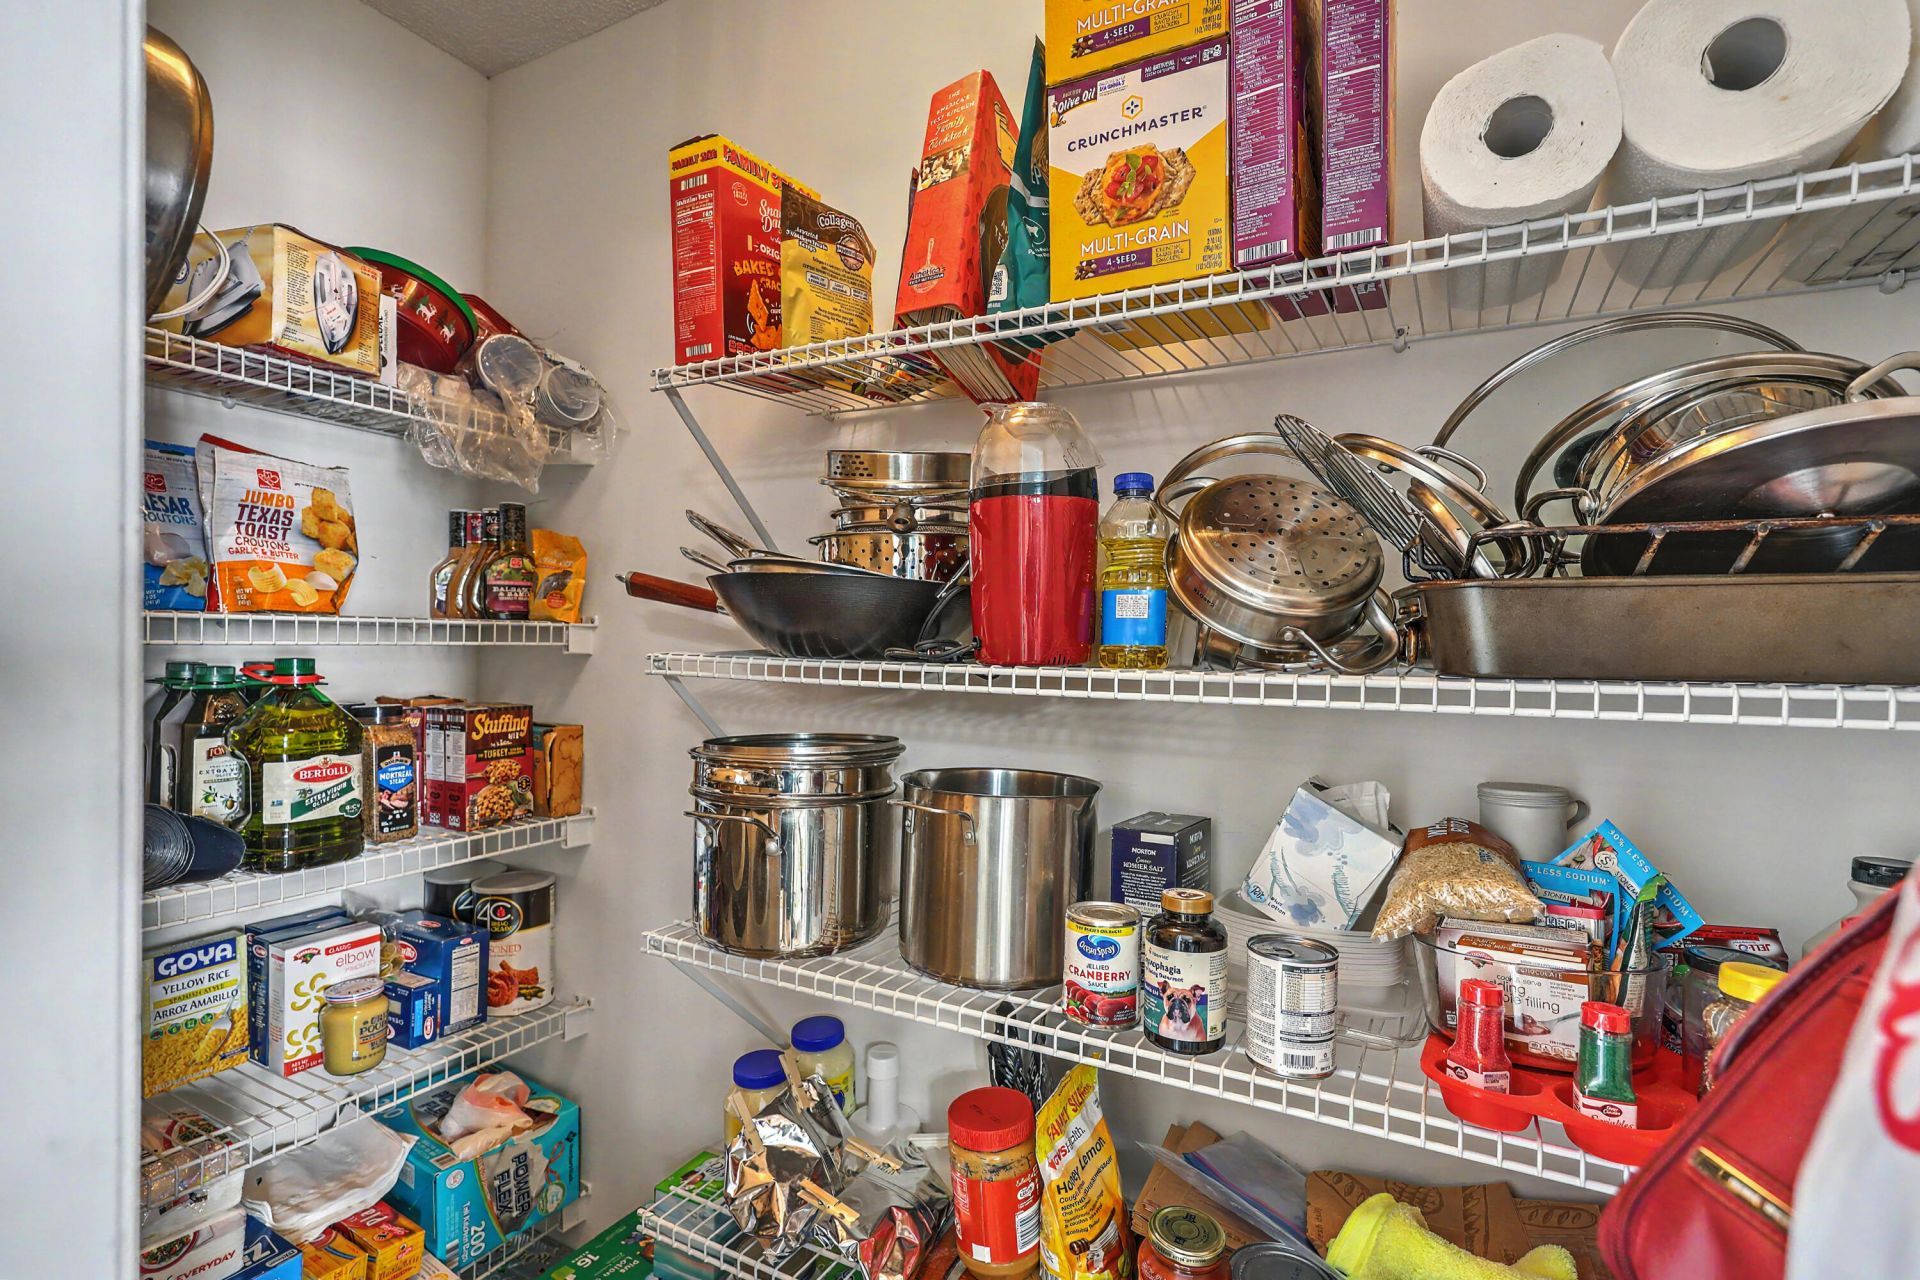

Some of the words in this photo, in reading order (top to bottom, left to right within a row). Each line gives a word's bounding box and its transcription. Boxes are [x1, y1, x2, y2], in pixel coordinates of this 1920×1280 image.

[1104, 24, 1135, 40] 4-SEED
[1057, 95, 1080, 114] Olive
[1082, 88, 1095, 101] Oil
[1068, 107, 1203, 152] CRUNCHMASTER
[723, 144, 769, 184] FAMILY
[818, 213, 855, 230] Collagen
[1081, 219, 1190, 257] MULTI-GRAIN
[760, 244, 780, 260] ORIG
[1106, 253, 1137, 266] 4-SEED
[734, 259, 774, 276] BAKED
[144, 494, 194, 516] ESAR
[240, 489, 295, 509] JUMBO
[237, 504, 294, 527] TEXAS
[235, 522, 291, 541] TOAST
[228, 547, 258, 556] GARLIC
[235, 536, 291, 551] CROUTONS
[471, 714, 530, 740] Stuffing
[299, 765, 349, 780] BERTOLLI
[379, 770, 413, 780] MONTREAL
[1131, 847, 1156, 856] MORTON
[1608, 830, 1625, 848] 30%
[1625, 849, 1650, 873] LESS
[1123, 861, 1148, 870] KOSHER
[1537, 866, 1562, 877] LESS
[328, 944, 352, 954] CLASSIC
[335, 947, 376, 968] elbow
[1096, 945, 1115, 958] Spray
[158, 943, 236, 976] GOYA
[1086, 963, 1109, 971] JELLIED
[1068, 964, 1131, 981] CRANBERRY
[1496, 973, 1514, 981] cook
[1519, 968, 1563, 980] CHOCOLATE
[163, 977, 205, 995] YELLOW
[208, 970, 231, 983] RICE
[154, 1006, 188, 1021] ARROZ
[190, 988, 239, 1010] AMARILLO
[1525, 996, 1560, 1014] filling
[1056, 1166, 1081, 1195] Honey
[1079, 1136, 1106, 1171] Lemon
[494, 1168, 513, 1216] FLEX
[512, 1152, 531, 1217] POWER
[470, 1220, 486, 1257] 200
[175, 1250, 236, 1280] EVERYDAY
[576, 1254, 600, 1268] 16
[602, 1255, 633, 1277] Lotion
[619, 1259, 640, 1274] plus
